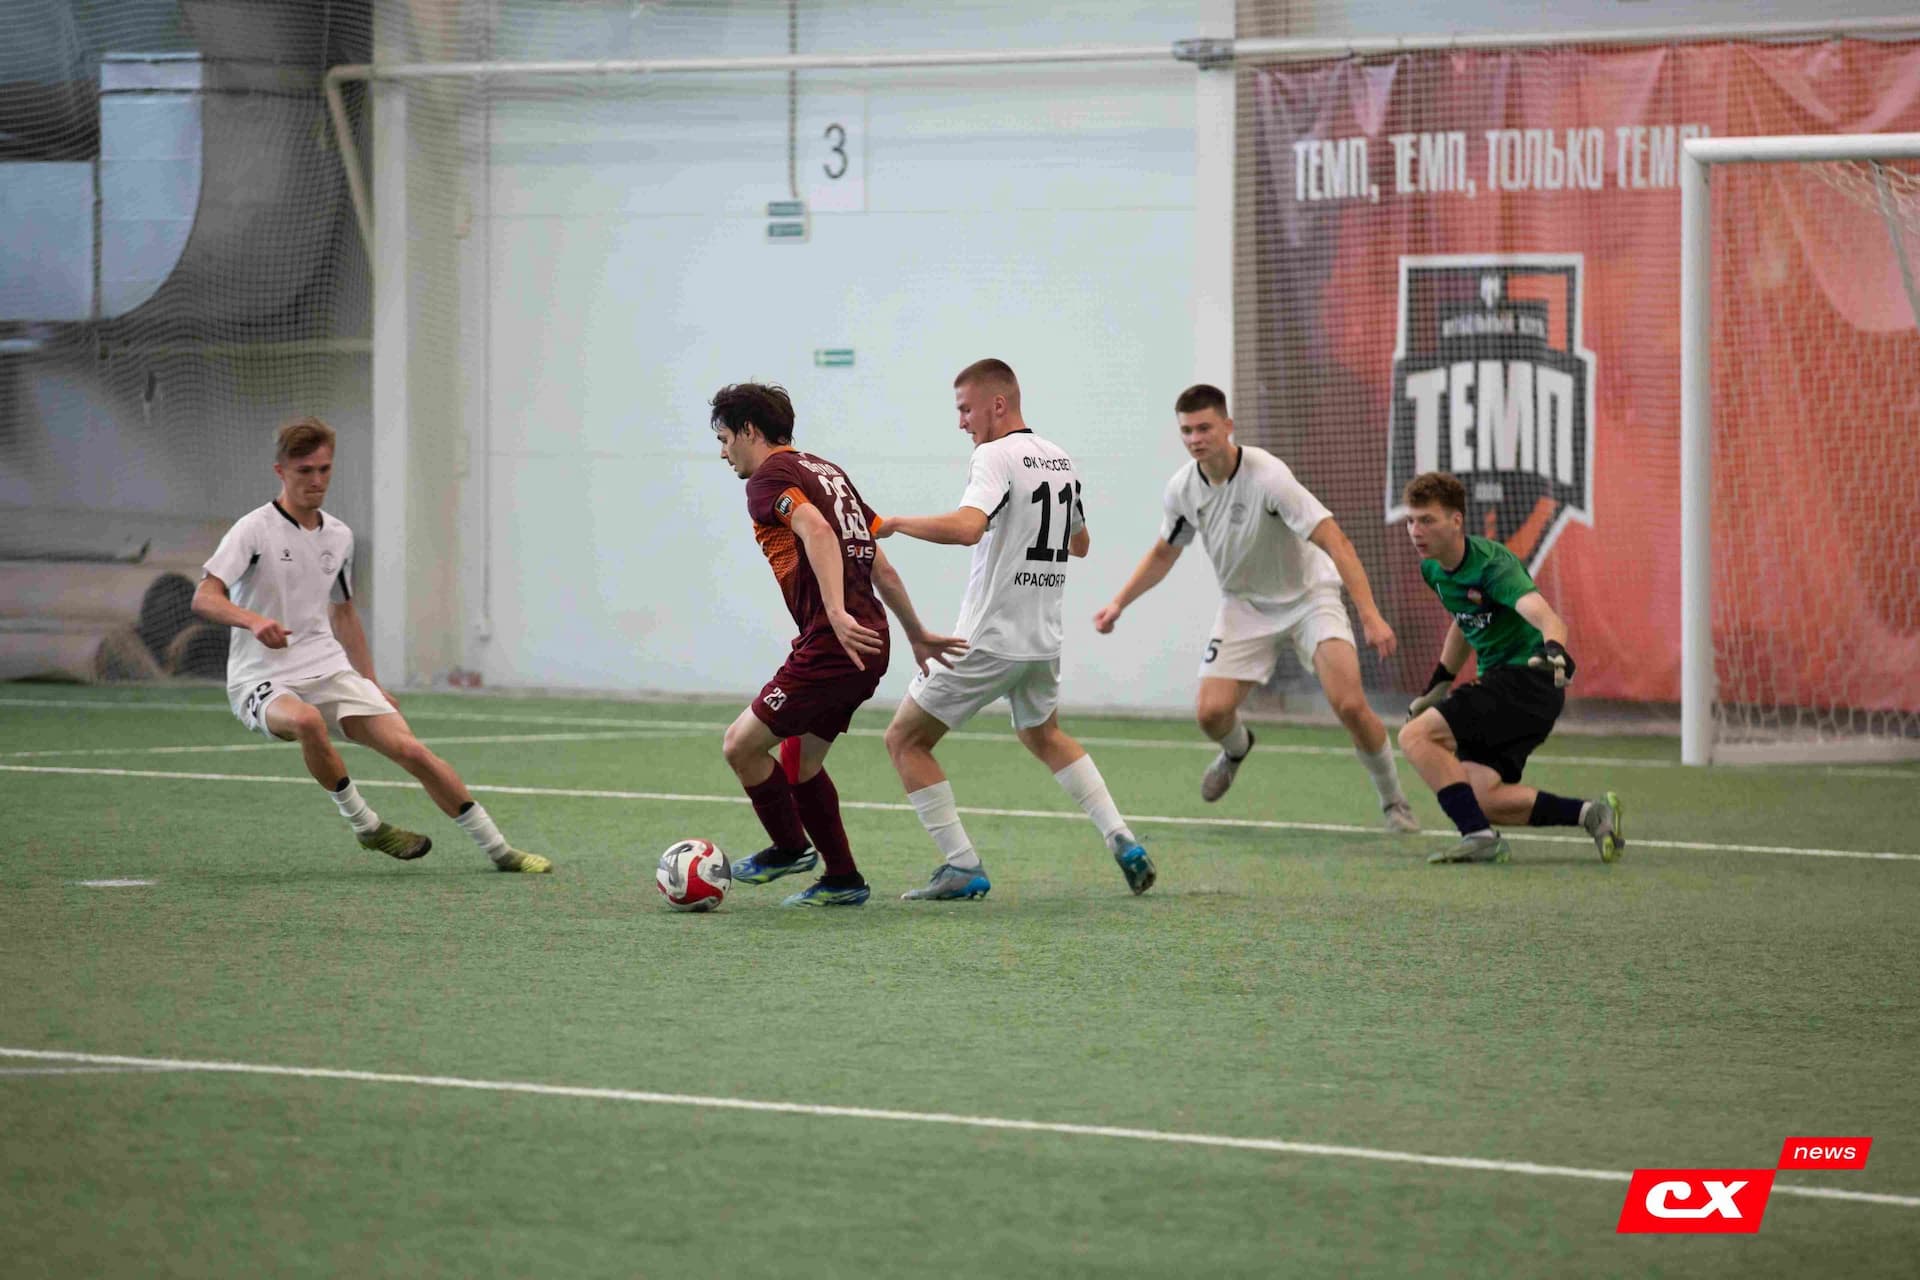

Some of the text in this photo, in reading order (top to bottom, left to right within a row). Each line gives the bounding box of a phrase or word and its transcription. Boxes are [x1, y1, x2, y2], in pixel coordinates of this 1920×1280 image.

[823, 122, 848, 179] 3
[1293, 124, 1710, 203] ТЕМП, ТЕМП, ТОЛЬКО ТЕМ
[1405, 360, 1574, 487] ТЕМП
[1023, 456, 1039, 469] ФК
[818, 474, 870, 541] 23
[1026, 481, 1073, 563] 11
[763, 686, 788, 712] 23
